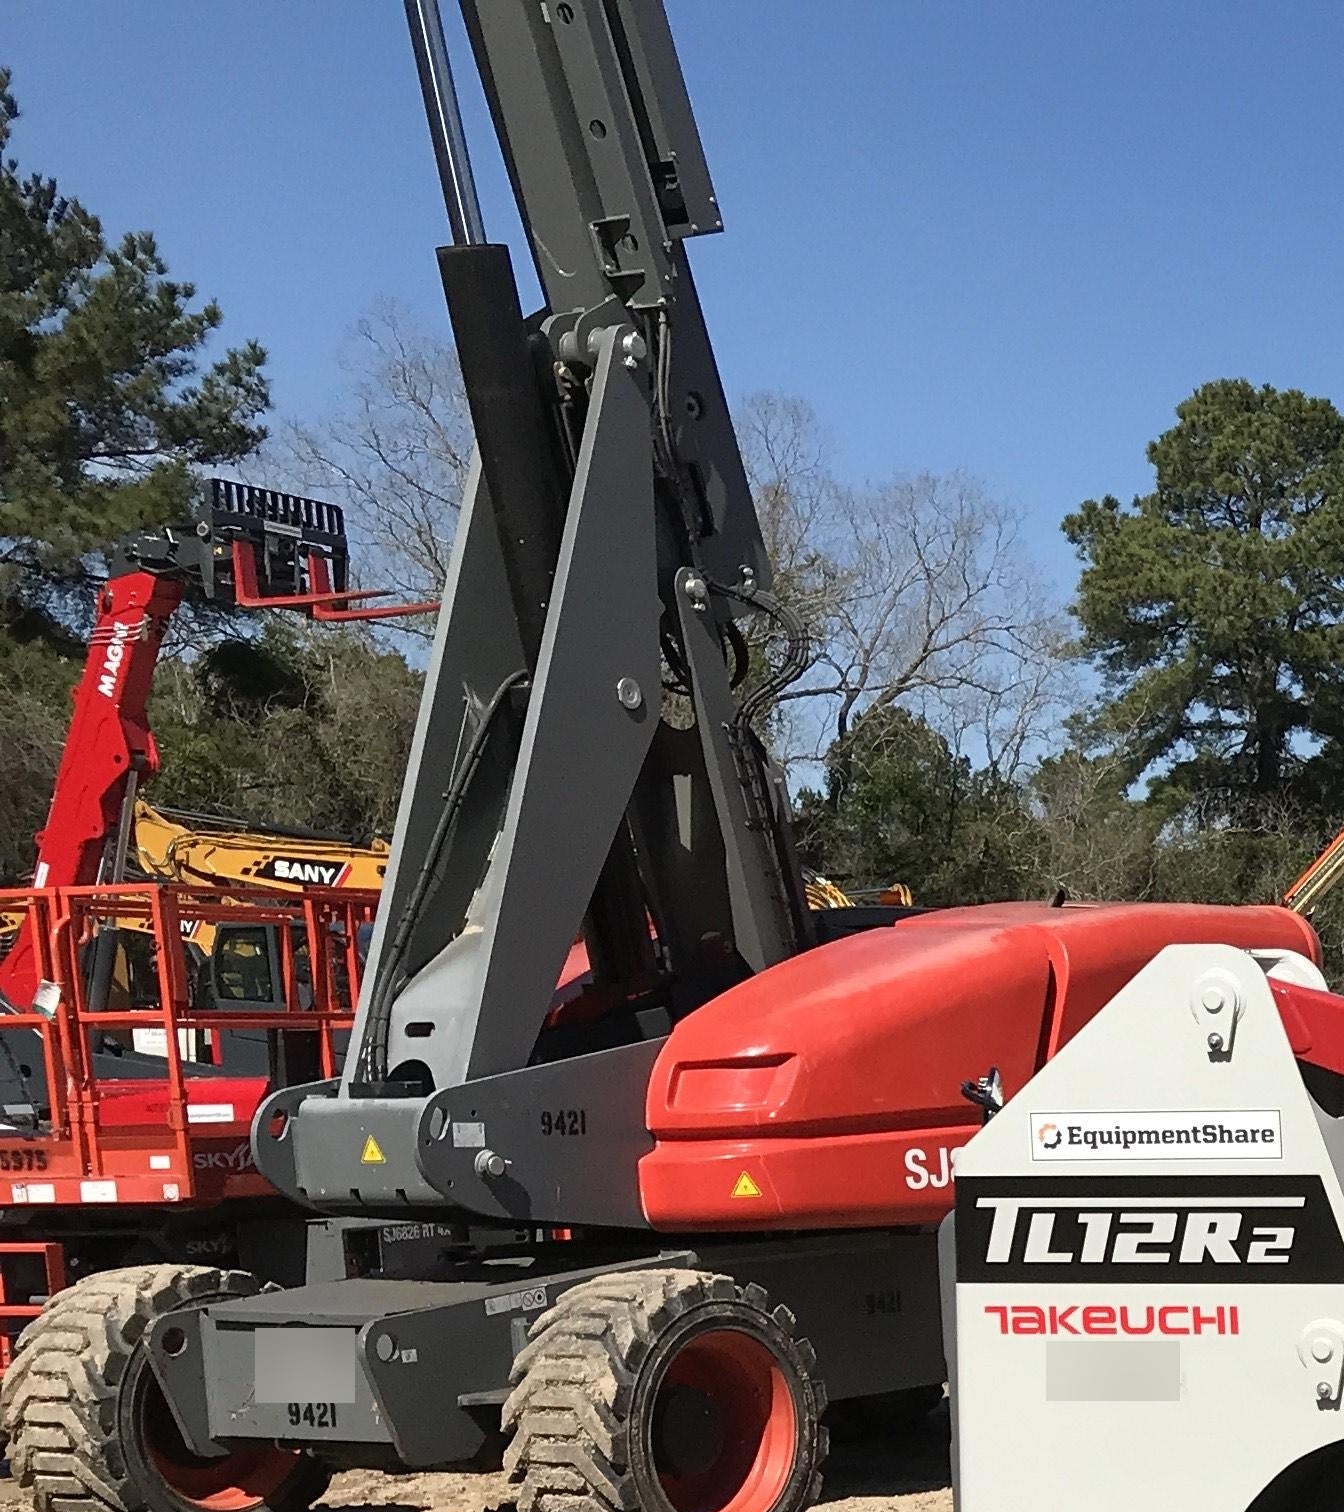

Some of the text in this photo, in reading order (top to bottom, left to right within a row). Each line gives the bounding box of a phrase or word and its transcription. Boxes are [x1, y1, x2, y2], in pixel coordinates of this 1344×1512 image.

[274, 860, 335, 884] SANY
[541, 1109, 586, 1136] 9421
[1067, 1124, 1275, 1150] EquipmentShare
[975, 1196, 1306, 1263] TL12R2
[984, 1305, 1240, 1335] TAKEUCHI
[288, 1403, 337, 1428] 9421
